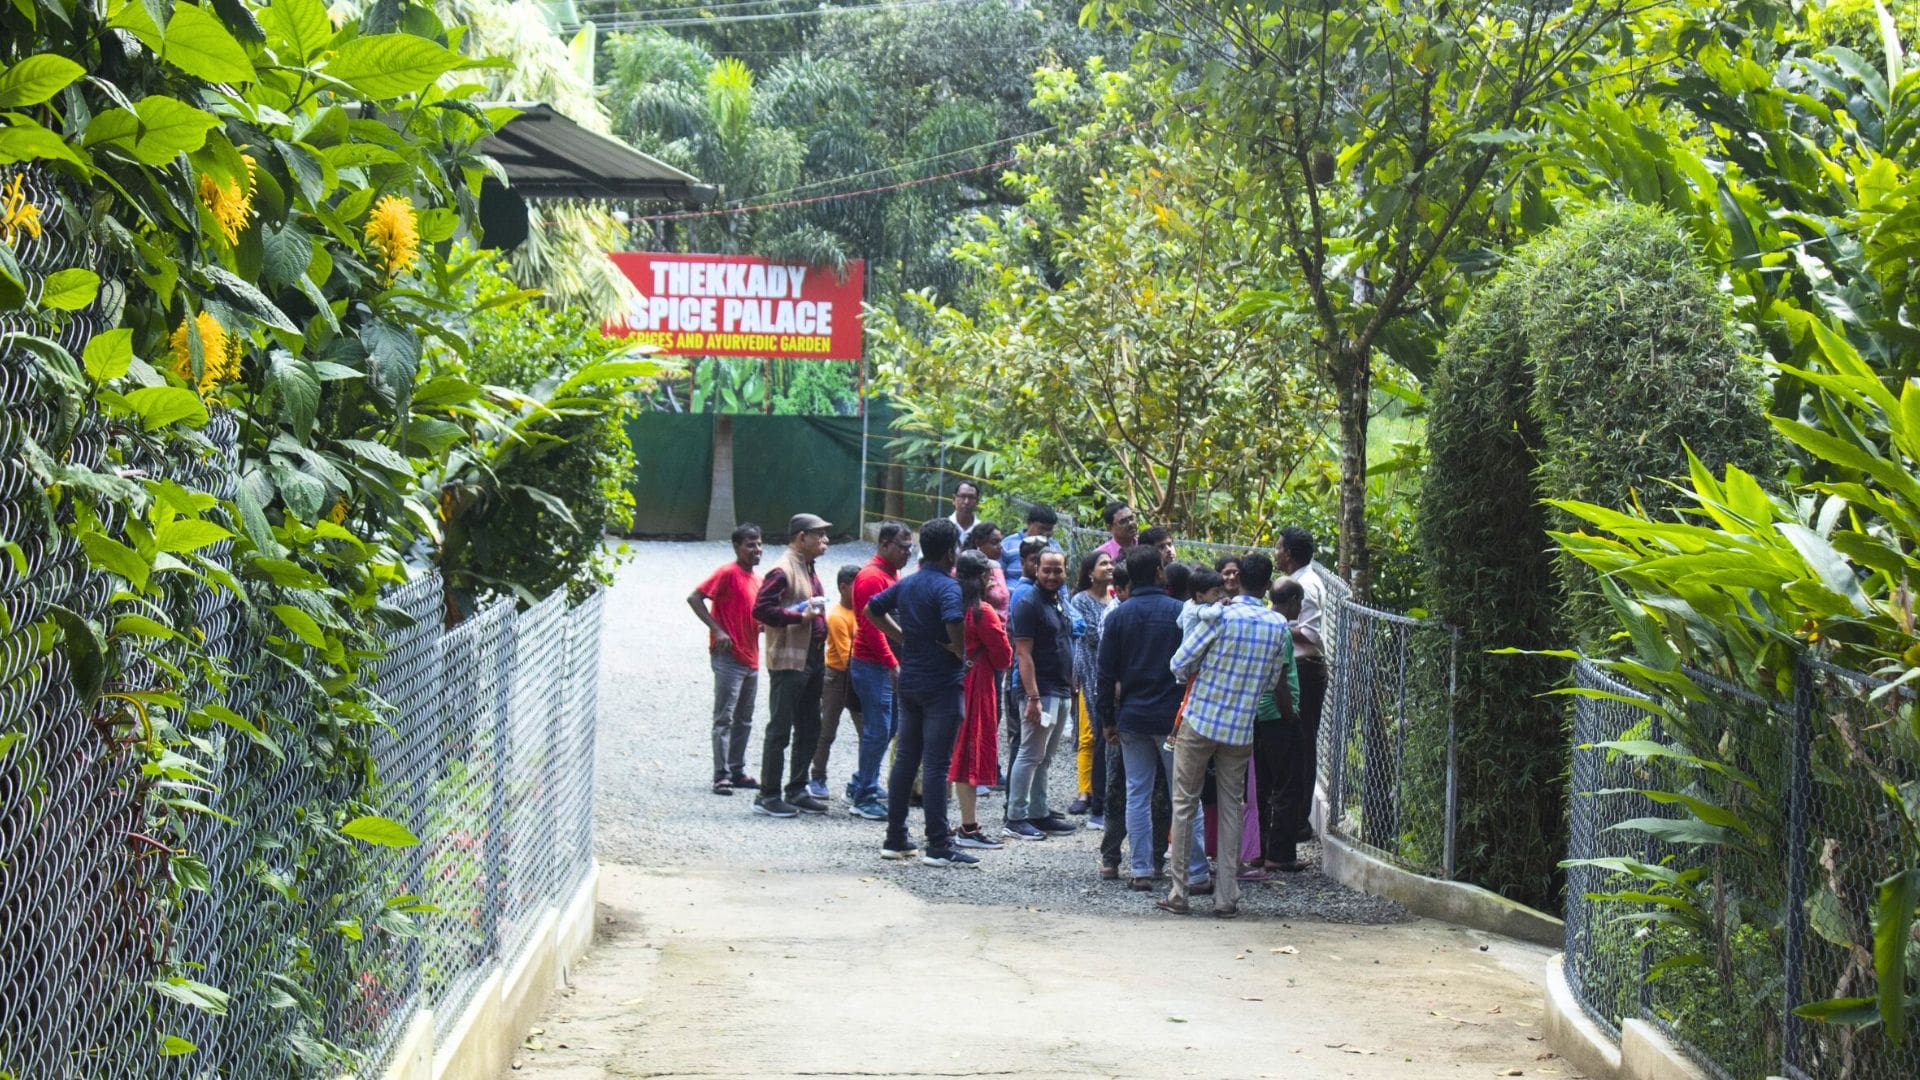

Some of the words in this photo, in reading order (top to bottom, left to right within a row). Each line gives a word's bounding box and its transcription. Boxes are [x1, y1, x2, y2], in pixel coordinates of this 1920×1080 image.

[650, 261, 807, 298] THEKKADY
[628, 296, 717, 331] SPICE
[723, 298, 832, 335] PALACE
[628, 331, 673, 349] SPICES
[676, 333, 704, 349] AND
[706, 333, 778, 351] AYURVEDIC
[780, 335, 831, 352] GARDEN
